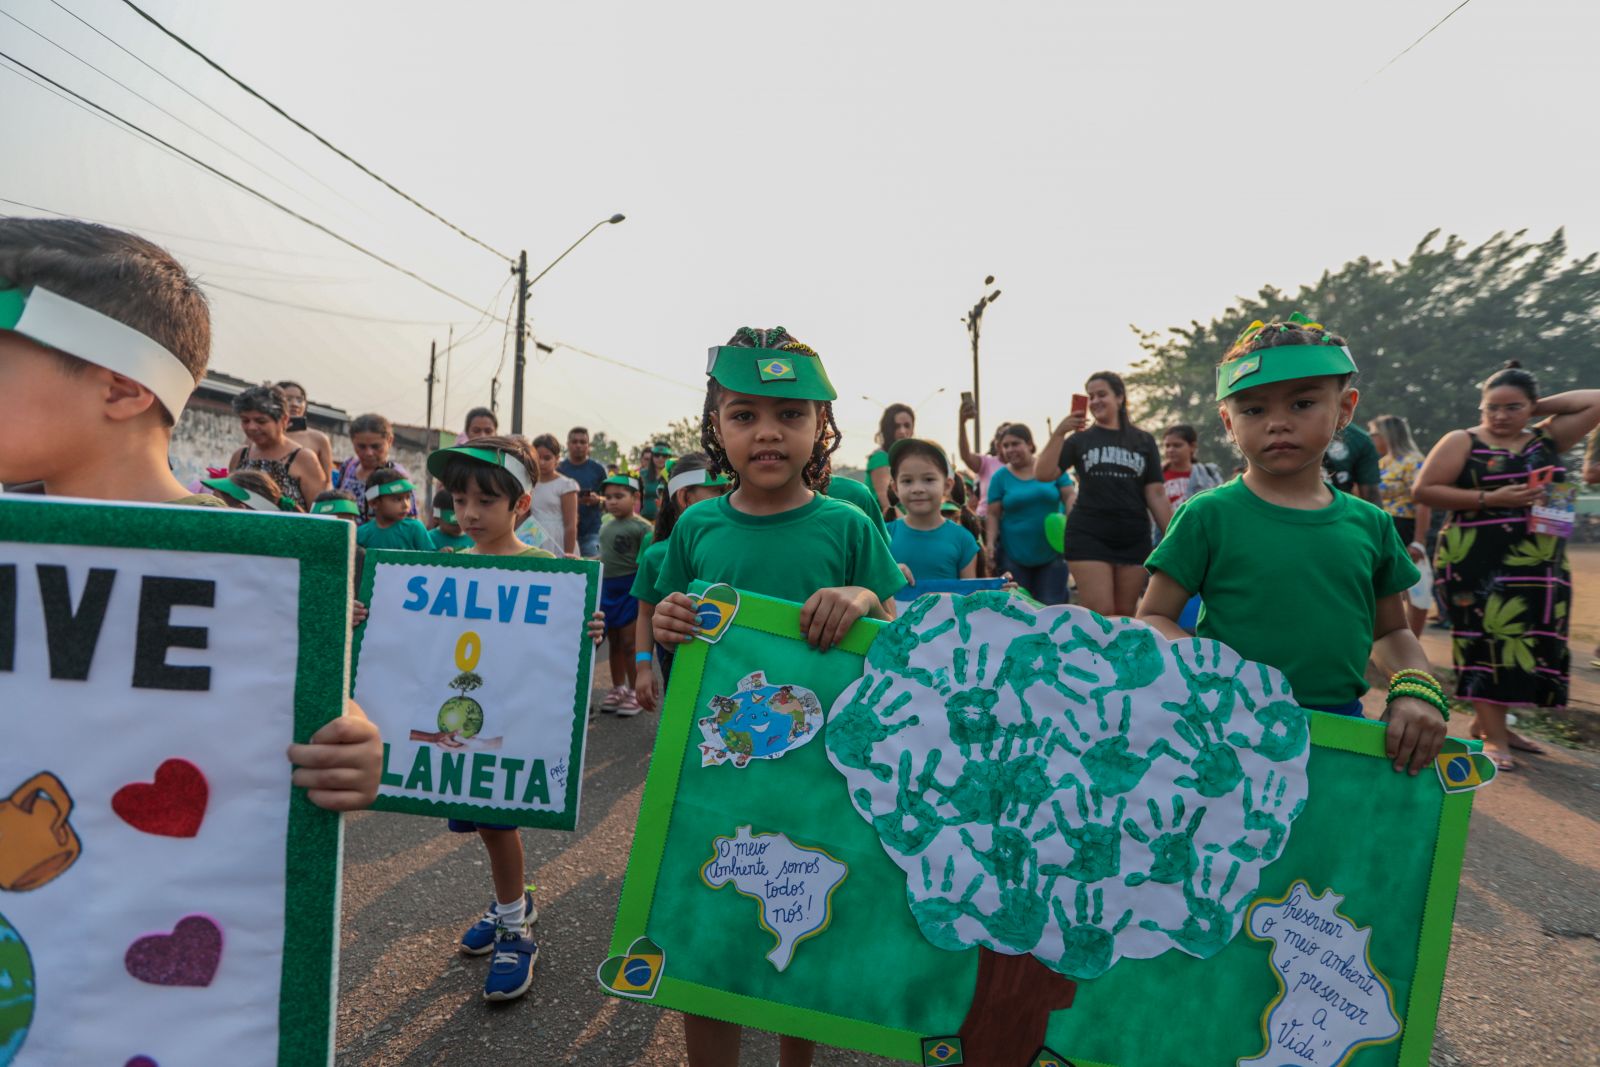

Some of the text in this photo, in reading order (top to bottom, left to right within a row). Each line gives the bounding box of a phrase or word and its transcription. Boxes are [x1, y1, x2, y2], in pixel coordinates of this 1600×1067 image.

[402, 576, 552, 625] SALVE
[454, 631, 481, 673] O
[380, 742, 551, 805] LANETA
[720, 840, 771, 858] O meio
[775, 856, 820, 880] somos
[764, 877, 805, 899] todos
[772, 895, 813, 924] nós!
[1284, 928, 1320, 956] meio
[1292, 971, 1370, 1026] preservar
